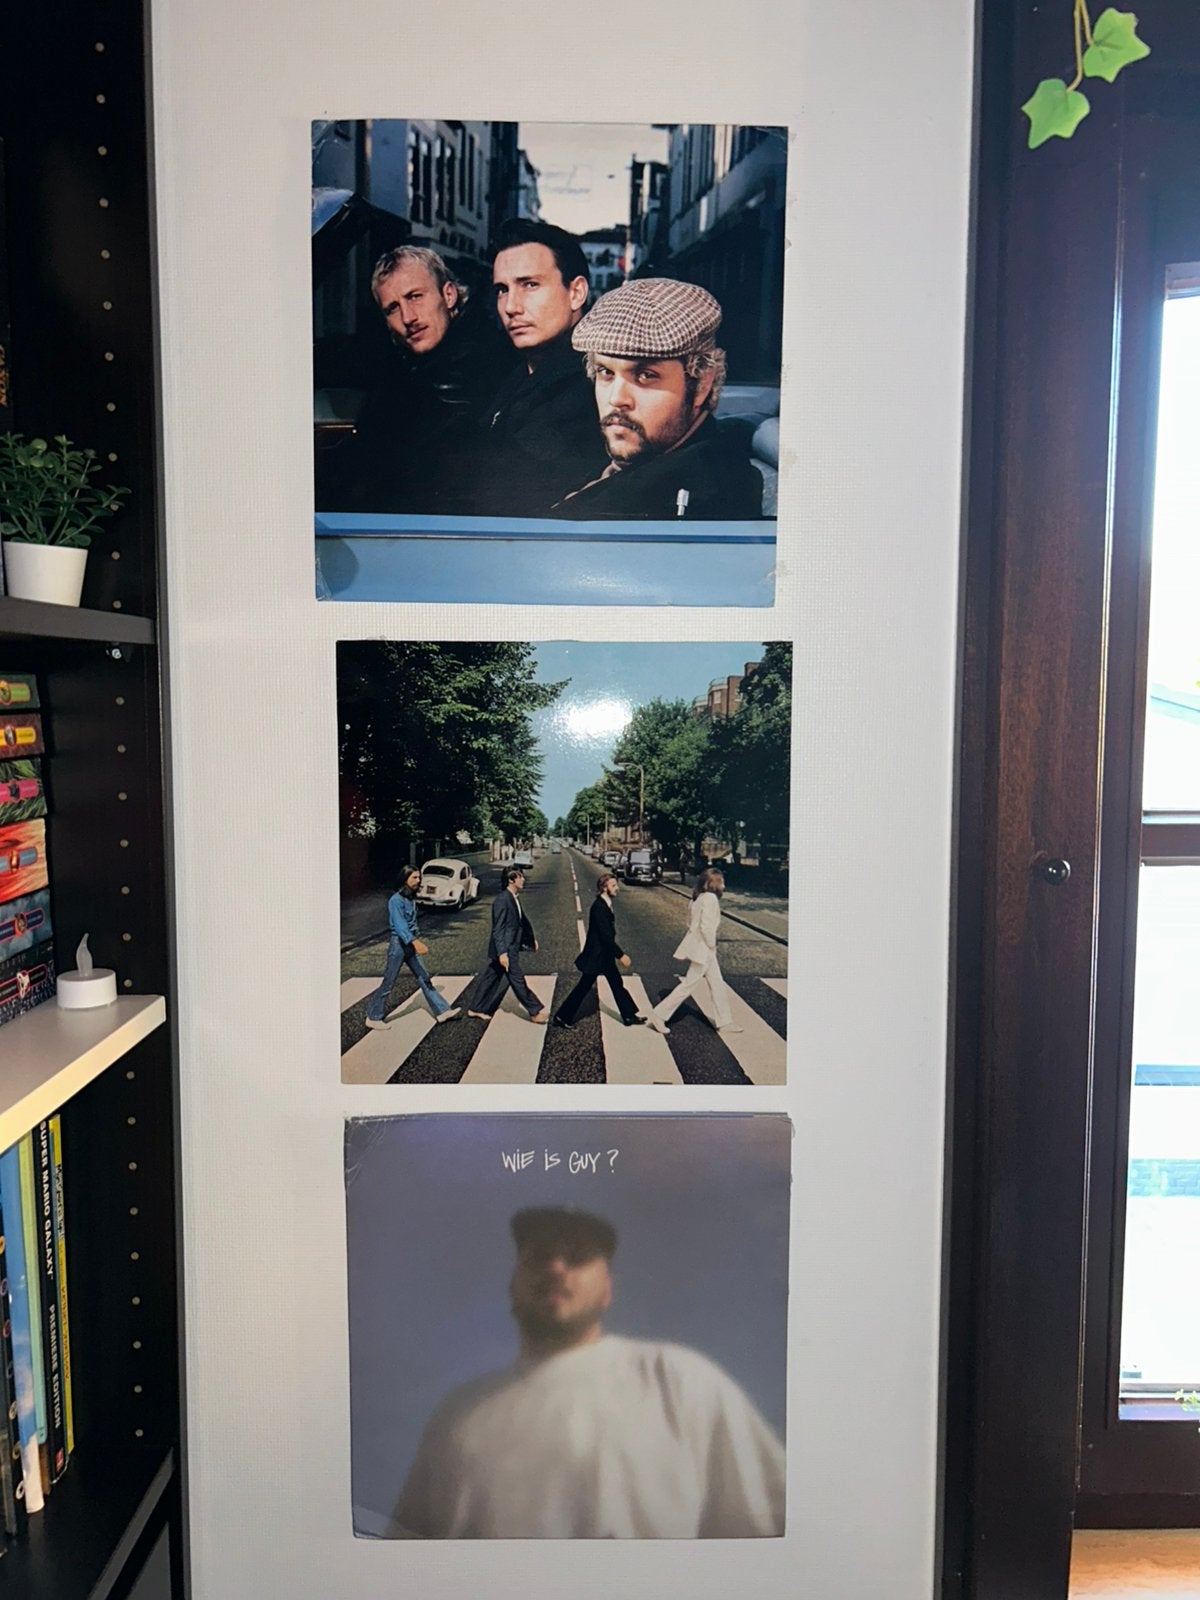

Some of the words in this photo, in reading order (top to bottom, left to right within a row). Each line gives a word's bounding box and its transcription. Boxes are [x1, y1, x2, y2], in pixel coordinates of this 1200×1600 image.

[40, 1121, 48, 1168] SUPER
[568, 1151, 601, 1174] GUY
[42, 1169, 50, 1217] MARIO
[44, 1219, 53, 1276] GALAXY
[49, 1303, 58, 1373] PREMIERE
[52, 1373, 61, 1429] EDITION
